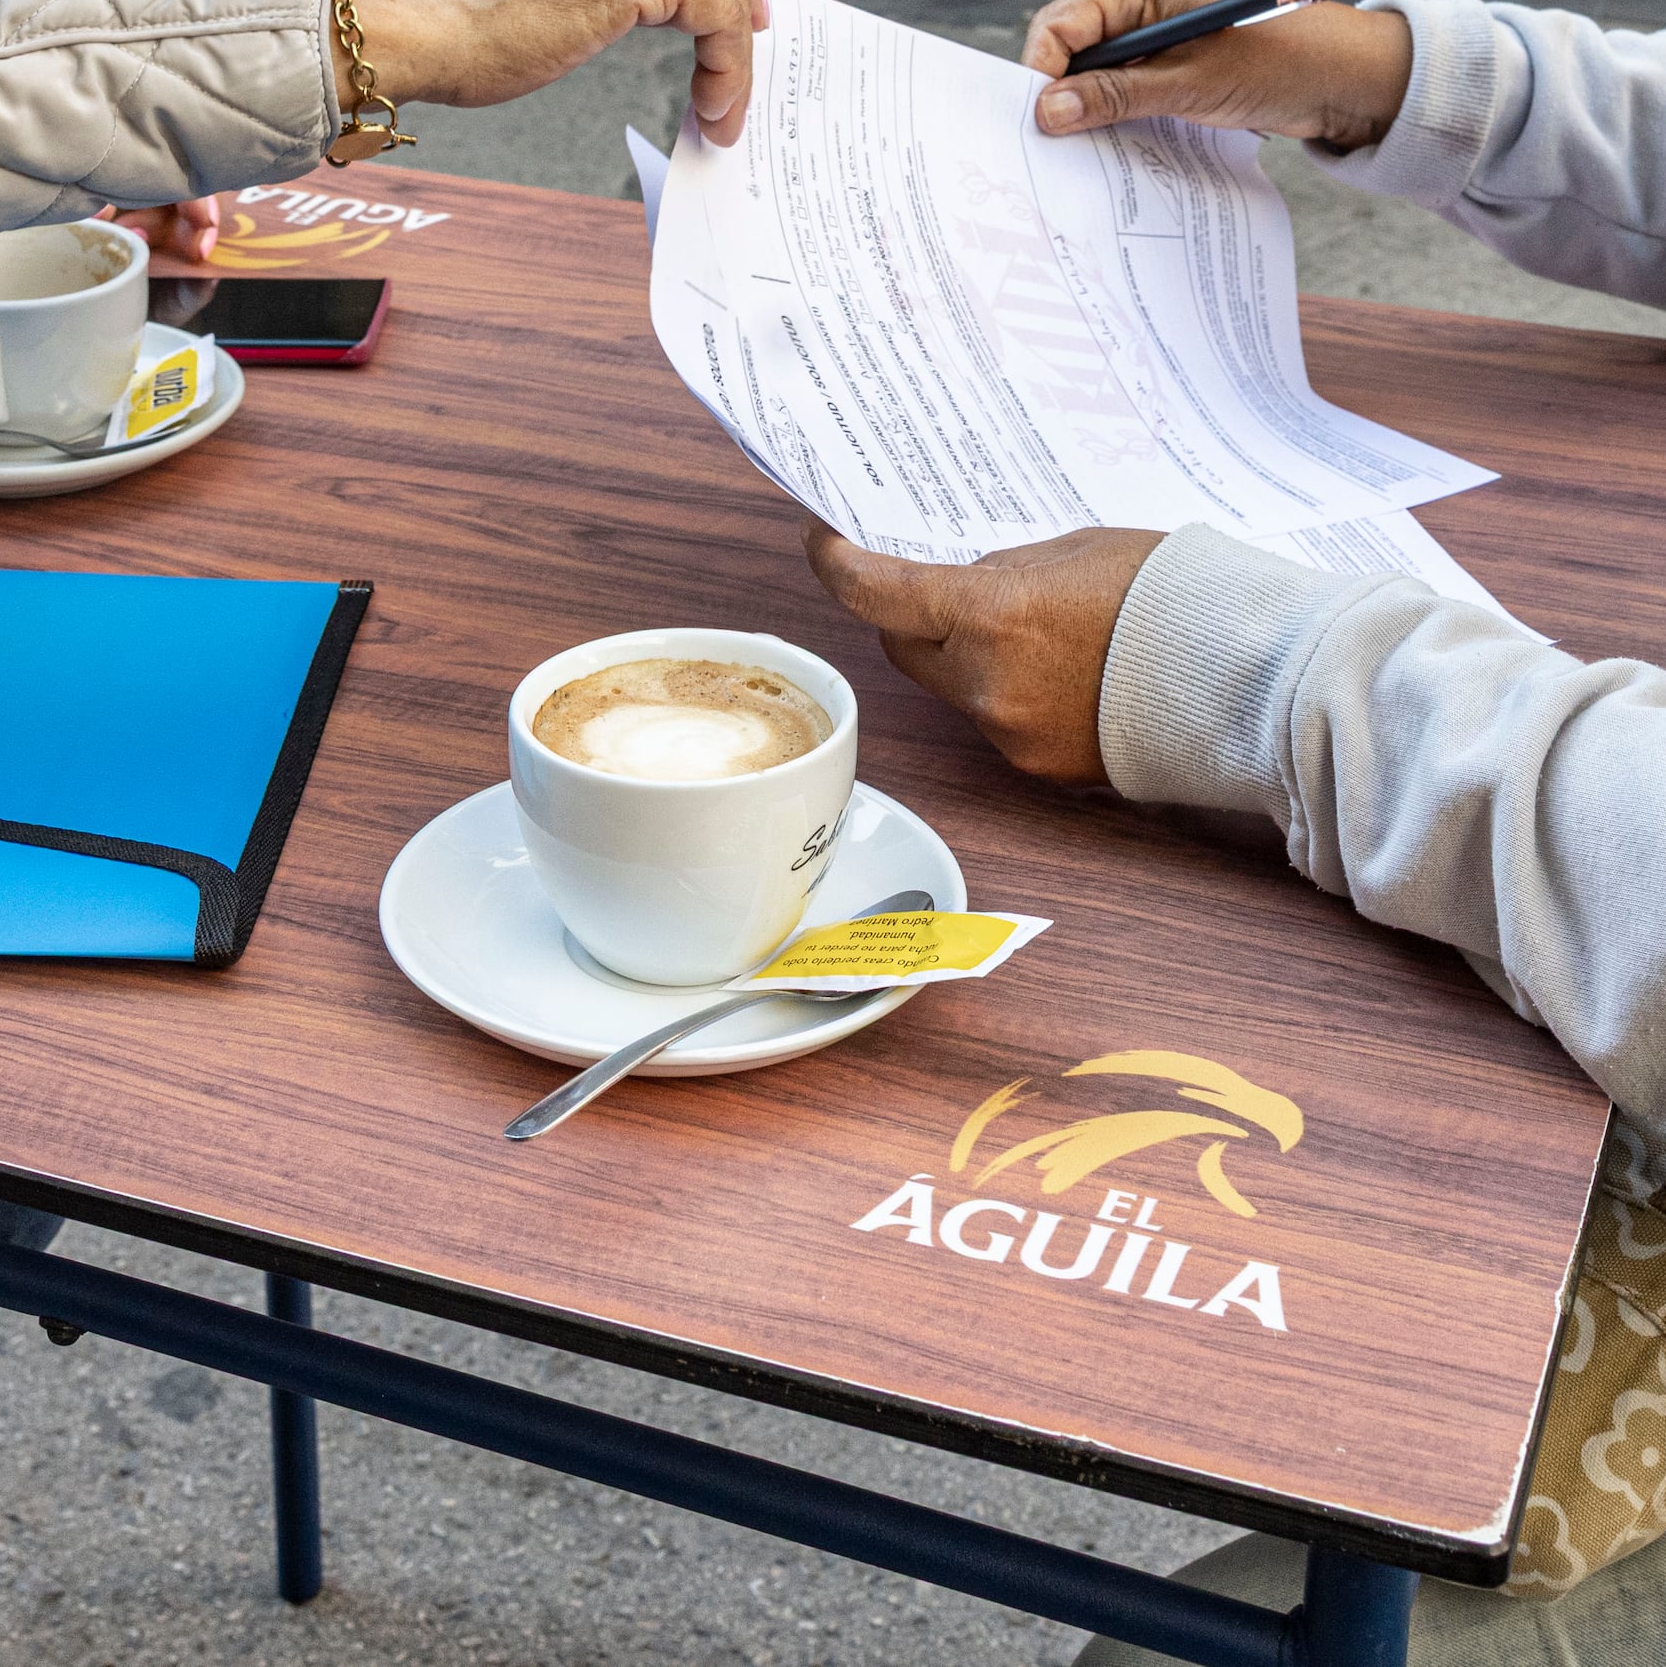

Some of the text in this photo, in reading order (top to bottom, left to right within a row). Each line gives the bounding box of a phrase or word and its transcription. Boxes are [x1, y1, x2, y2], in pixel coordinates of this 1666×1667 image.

[883, 263, 893, 277] DE
[888, 277, 912, 323] EFECTOS
[816, 318, 852, 379] SOLICITANTE
[834, 291, 880, 374] REPRESENTANTE
[875, 318, 908, 373] CONTACTO
[911, 330, 932, 364] DATOS
[778, 311, 827, 390] SOLICITUD
[847, 378, 872, 413] DATOS
[875, 371, 898, 407] DATOS
[903, 372, 916, 388] DE
[912, 387, 935, 420] DATOS
[897, 411, 944, 487] REPRESENTANT
[932, 421, 968, 477] CONTACTE
[964, 427, 976, 442] DE
[906, 481, 930, 517] DADES
[964, 476, 976, 490] DE
[939, 485, 963, 521] DADES
[972, 488, 996, 523] DADES
[1005, 492, 1030, 525] DADES
[849, 931, 916, 941] humanidad.
[902, 917, 935, 927] Pedro
[782, 957, 808, 966] todo
[812, 956, 861, 966] perderlo
[818, 943, 856, 952] perder
[861, 944, 876, 952] no
[879, 944, 904, 952] para
[1096, 1187, 1164, 1231] EL
